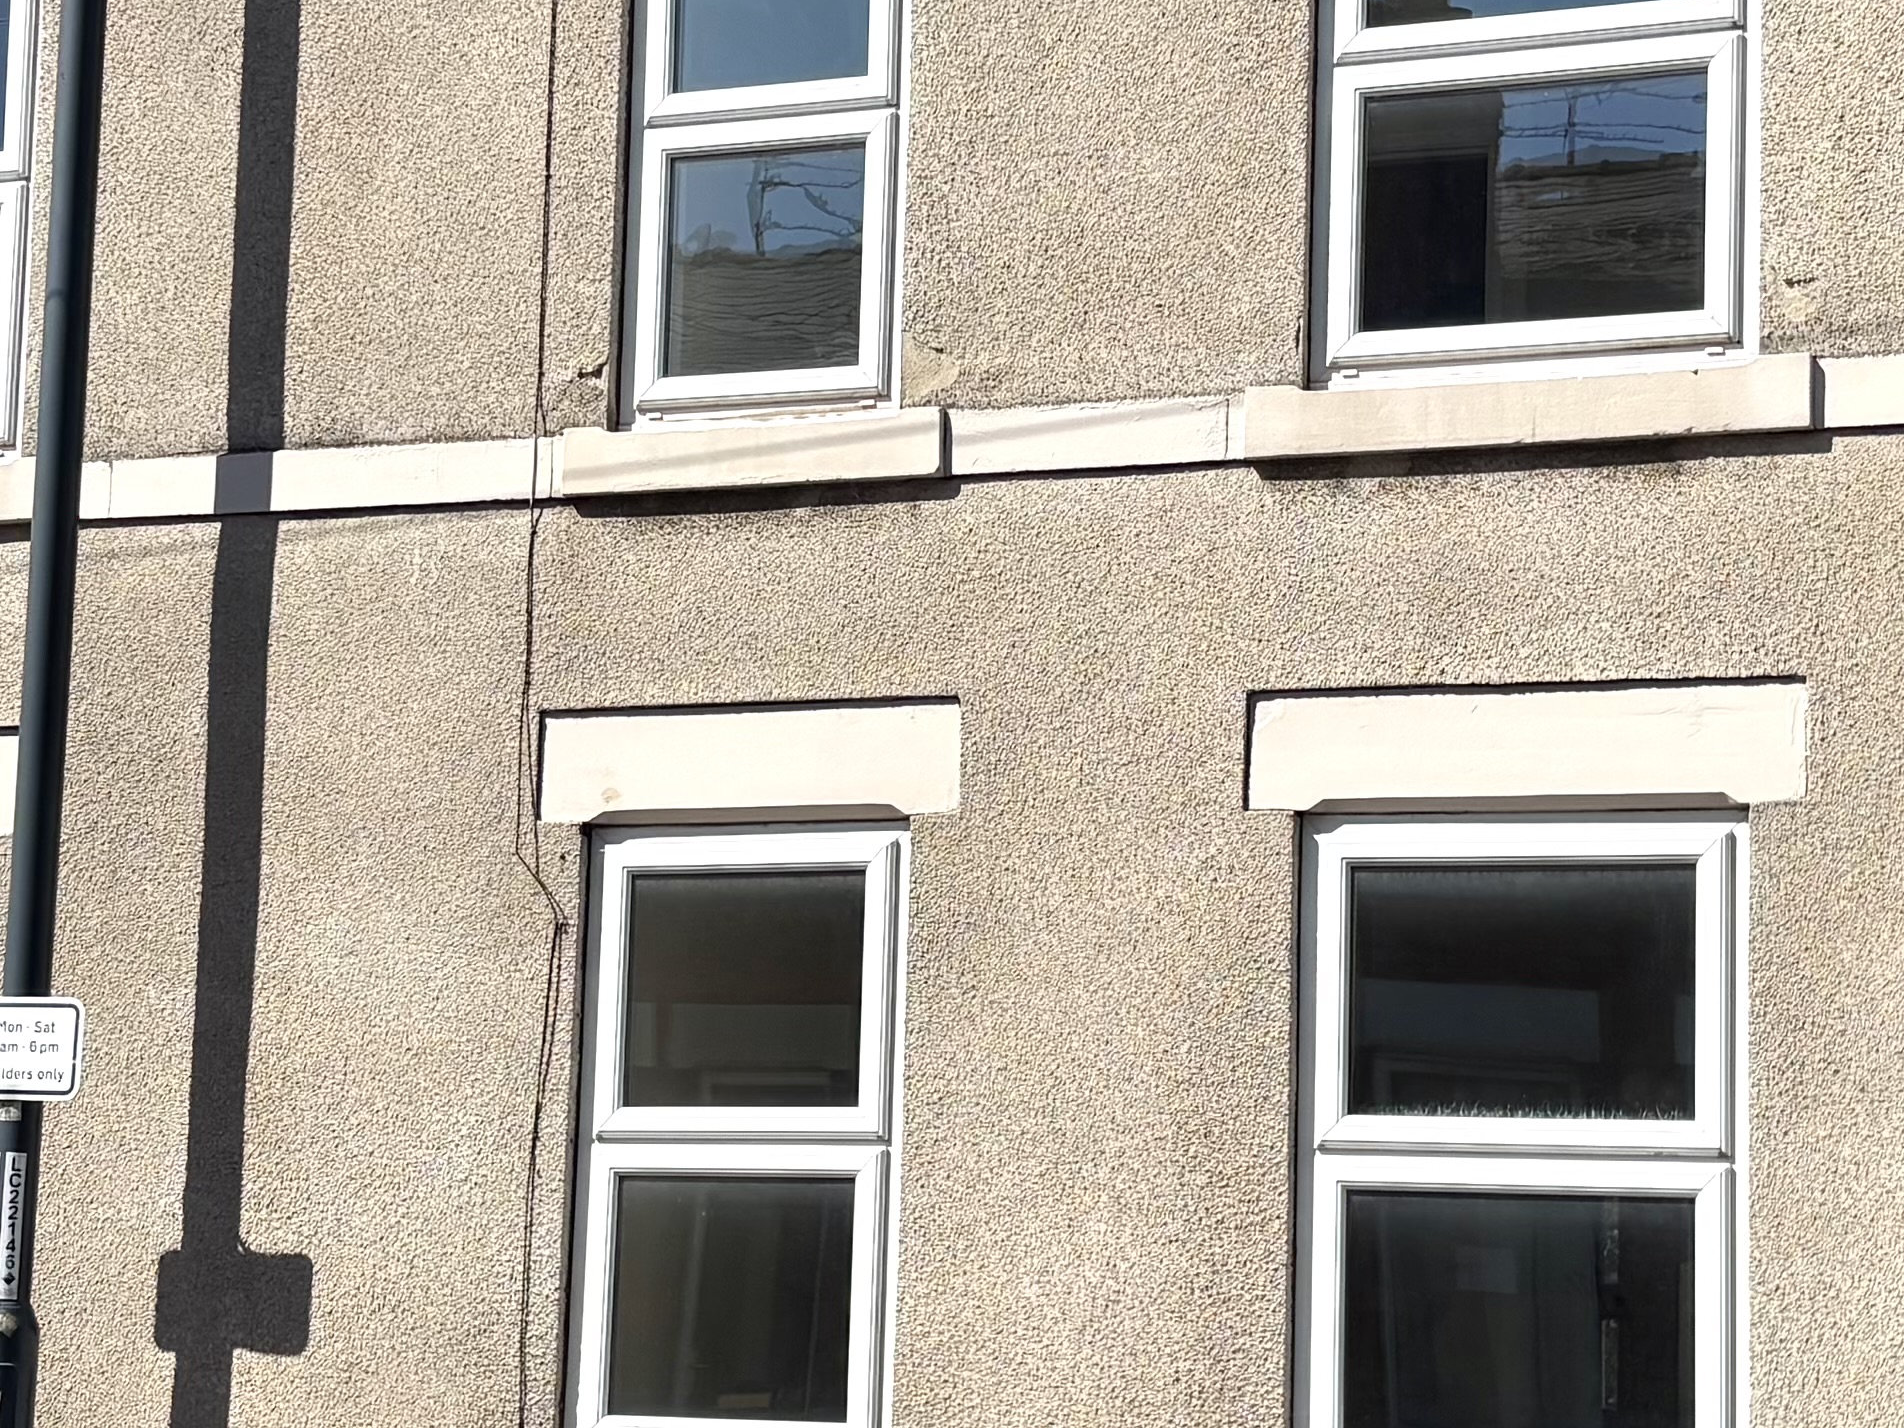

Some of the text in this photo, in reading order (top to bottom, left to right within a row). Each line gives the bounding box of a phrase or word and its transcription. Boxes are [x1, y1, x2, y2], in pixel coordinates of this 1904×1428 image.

[34, 1021, 55, 1033] Sat
[37, 1068, 64, 1082] only
[5, 1155, 22, 1270] LC22146
